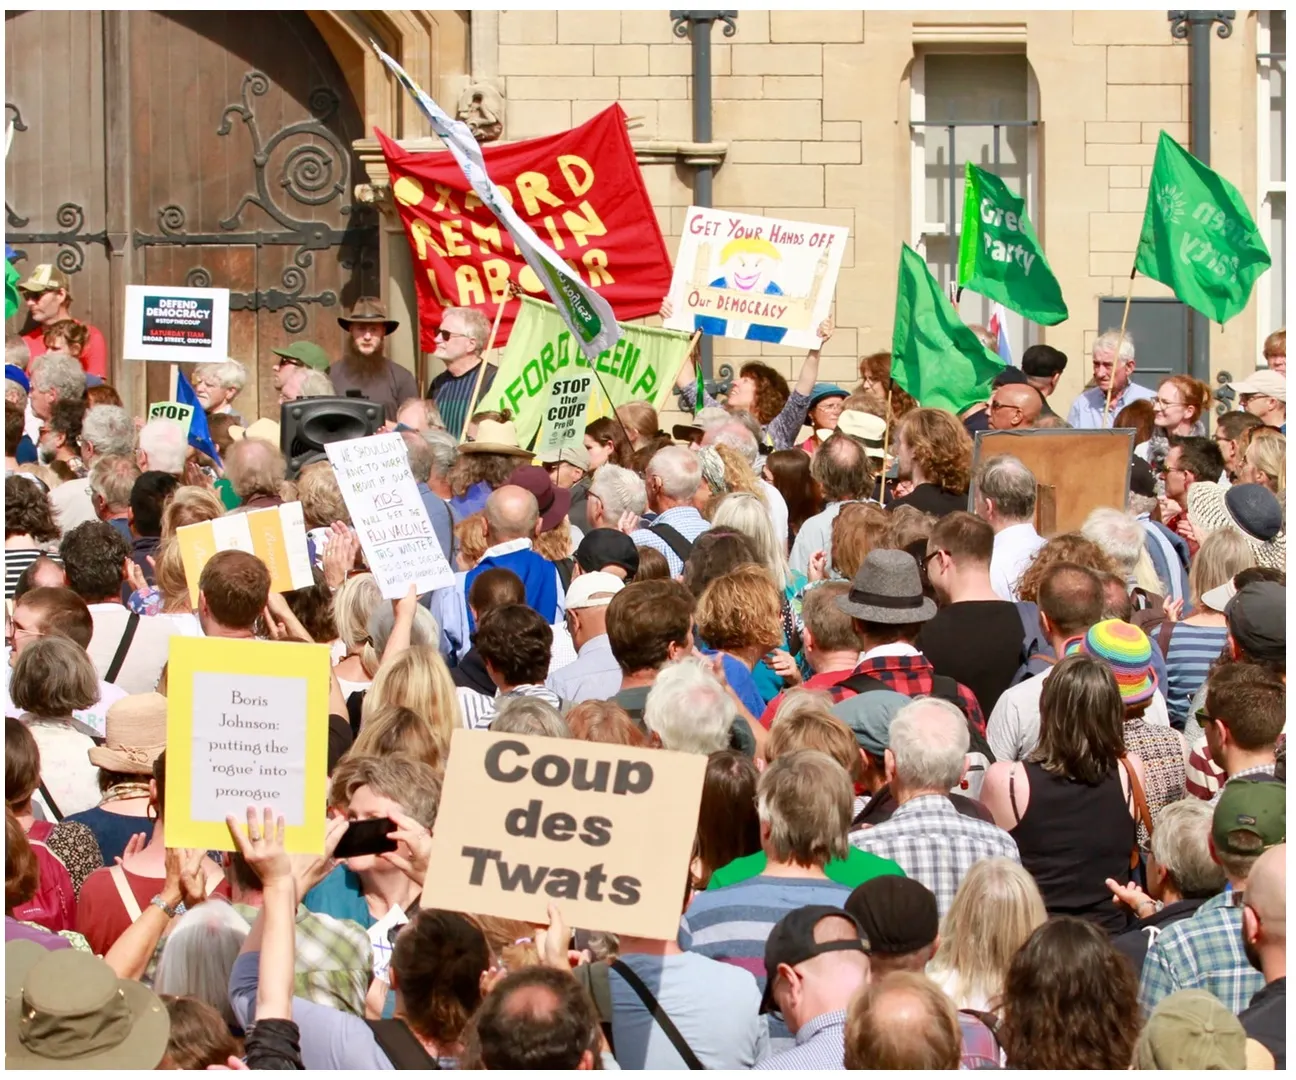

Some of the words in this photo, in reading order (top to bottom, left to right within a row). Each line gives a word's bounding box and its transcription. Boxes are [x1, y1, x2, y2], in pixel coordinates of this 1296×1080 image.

[980, 198, 1027, 235] Gree
[411, 200, 608, 260] REMIN
[690, 214, 721, 236] GET
[727, 218, 763, 240] YOUR
[770, 224, 804, 245] HANDS
[809, 233, 835, 248] OFF
[426, 248, 616, 306] LABOR
[160, 300, 197, 309] DEFEND
[716, 296, 788, 320] DEMOCRACY
[146, 308, 210, 319] DEMOCRACY
[164, 336, 186, 344] STREET,
[552, 378, 590, 395] STOP
[560, 396, 578, 404] the
[151, 406, 189, 420] STOP
[548, 404, 586, 421] COUP
[365, 462, 379, 472] TO
[392, 469, 412, 483] OUR
[372, 489, 402, 508] KIDS
[366, 529, 386, 542] FLU
[388, 520, 430, 539] VACCINE
[232, 690, 268, 706] Boris
[219, 713, 279, 730] Johnson:
[208, 741, 262, 755] putting
[265, 740, 288, 754] the
[259, 765, 287, 776] into
[484, 740, 654, 795] Coup
[216, 788, 280, 801] prorogue
[504, 799, 613, 846] des
[461, 846, 642, 906] Twats
